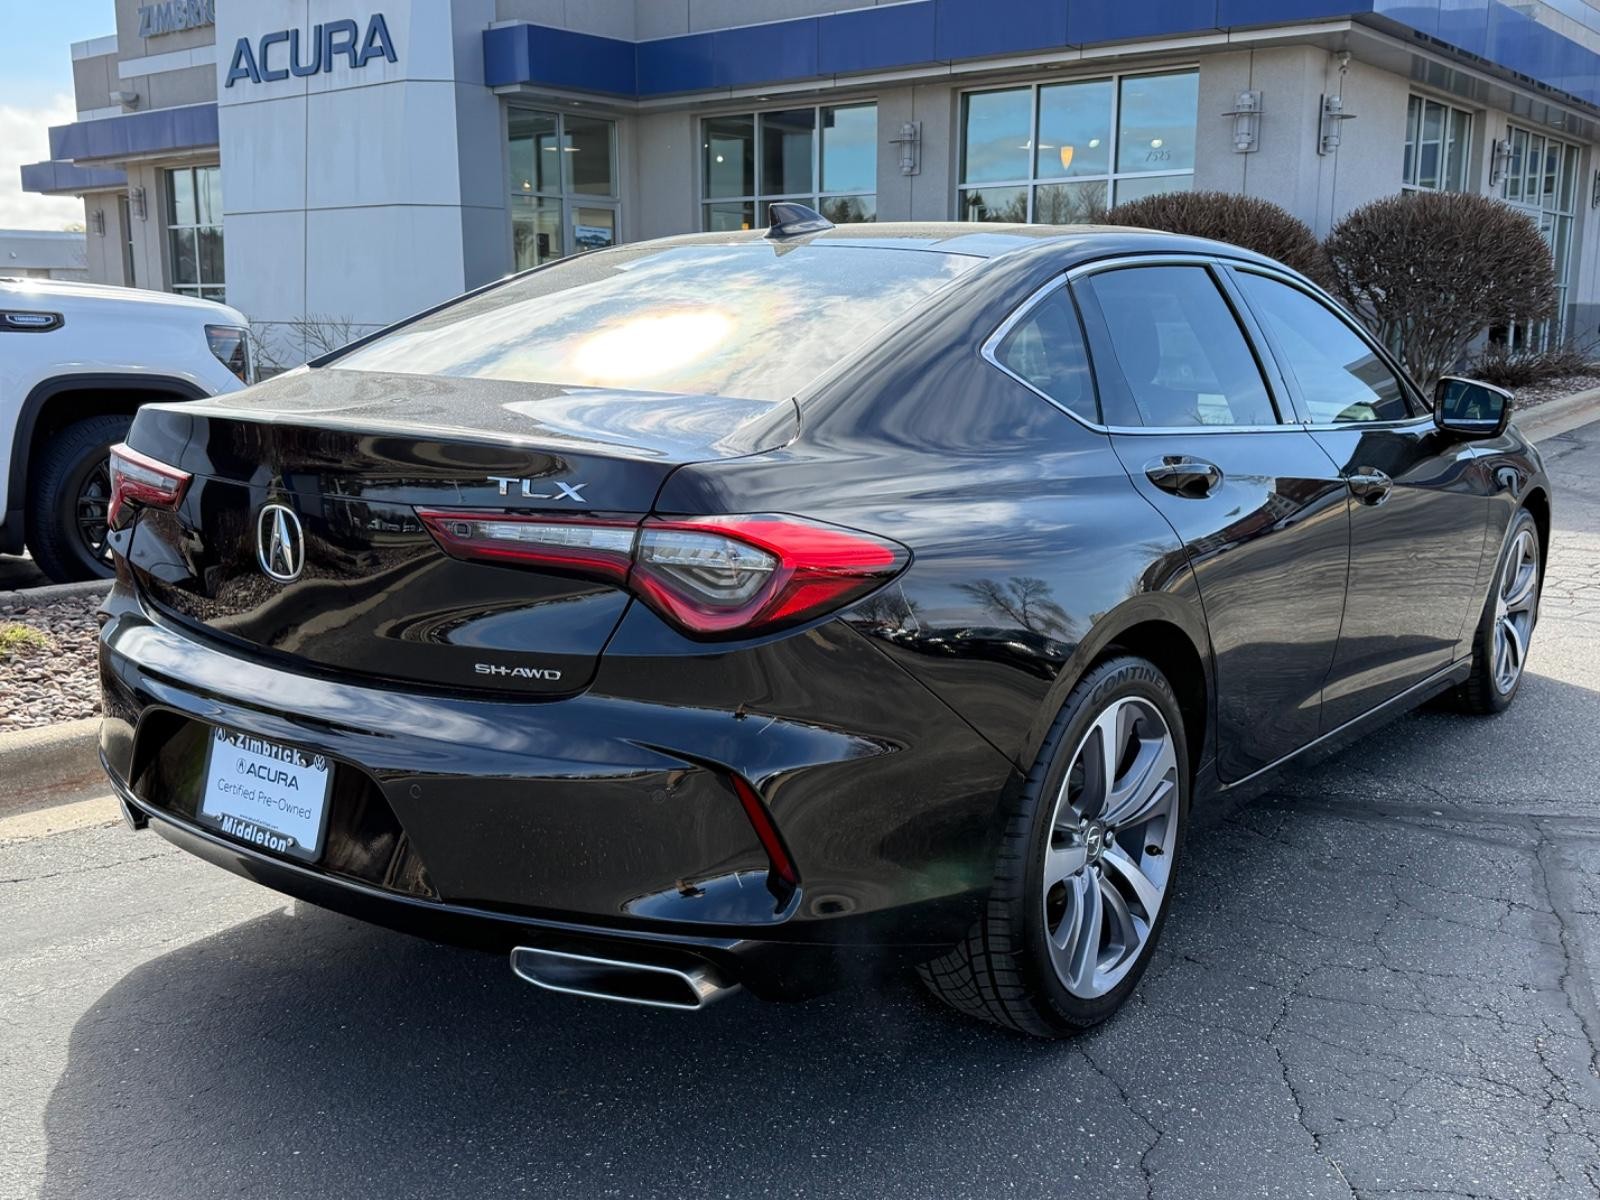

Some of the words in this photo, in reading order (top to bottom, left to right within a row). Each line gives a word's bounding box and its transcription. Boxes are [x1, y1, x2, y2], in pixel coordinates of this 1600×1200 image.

[225, 13, 398, 88] ACURA
[487, 476, 588, 502] TLX
[475, 663, 561, 680] SH-AWD
[236, 733, 302, 766] Zimbrick
[246, 763, 299, 790] ACURA
[217, 777, 255, 801] Certified
[258, 790, 312, 820] Pre-Owned
[221, 816, 287, 852] Middleton
